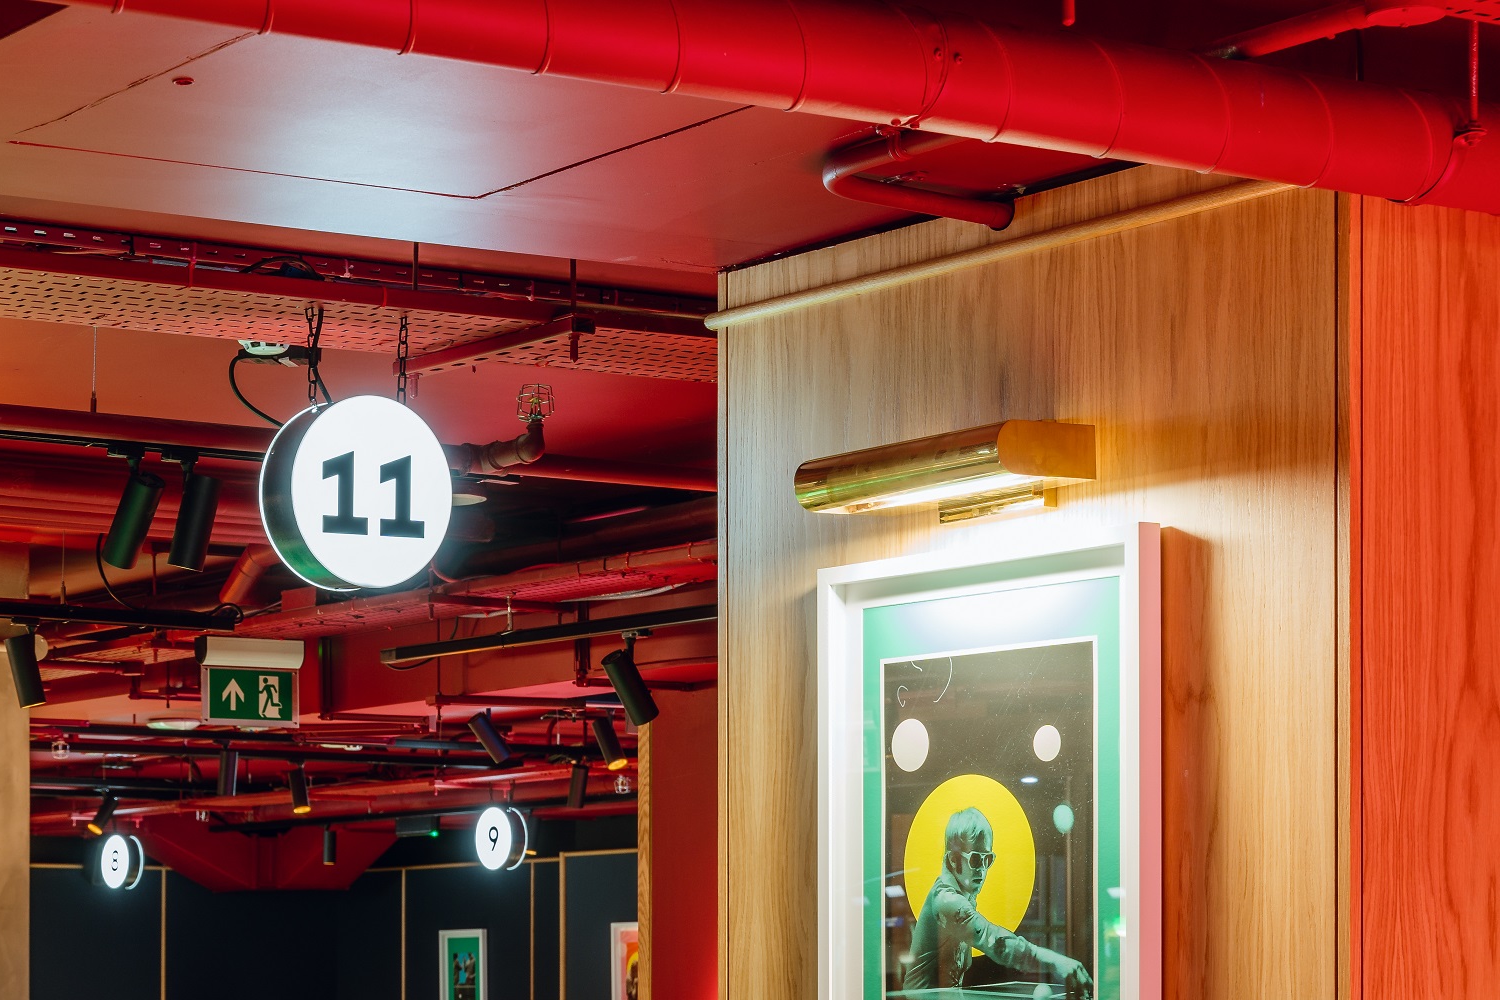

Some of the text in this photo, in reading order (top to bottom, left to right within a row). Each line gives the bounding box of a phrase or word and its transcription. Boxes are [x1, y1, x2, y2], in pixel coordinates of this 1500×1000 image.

[321, 450, 426, 539] 11
[488, 825, 499, 852] 9
[111, 849, 119, 872] 8
